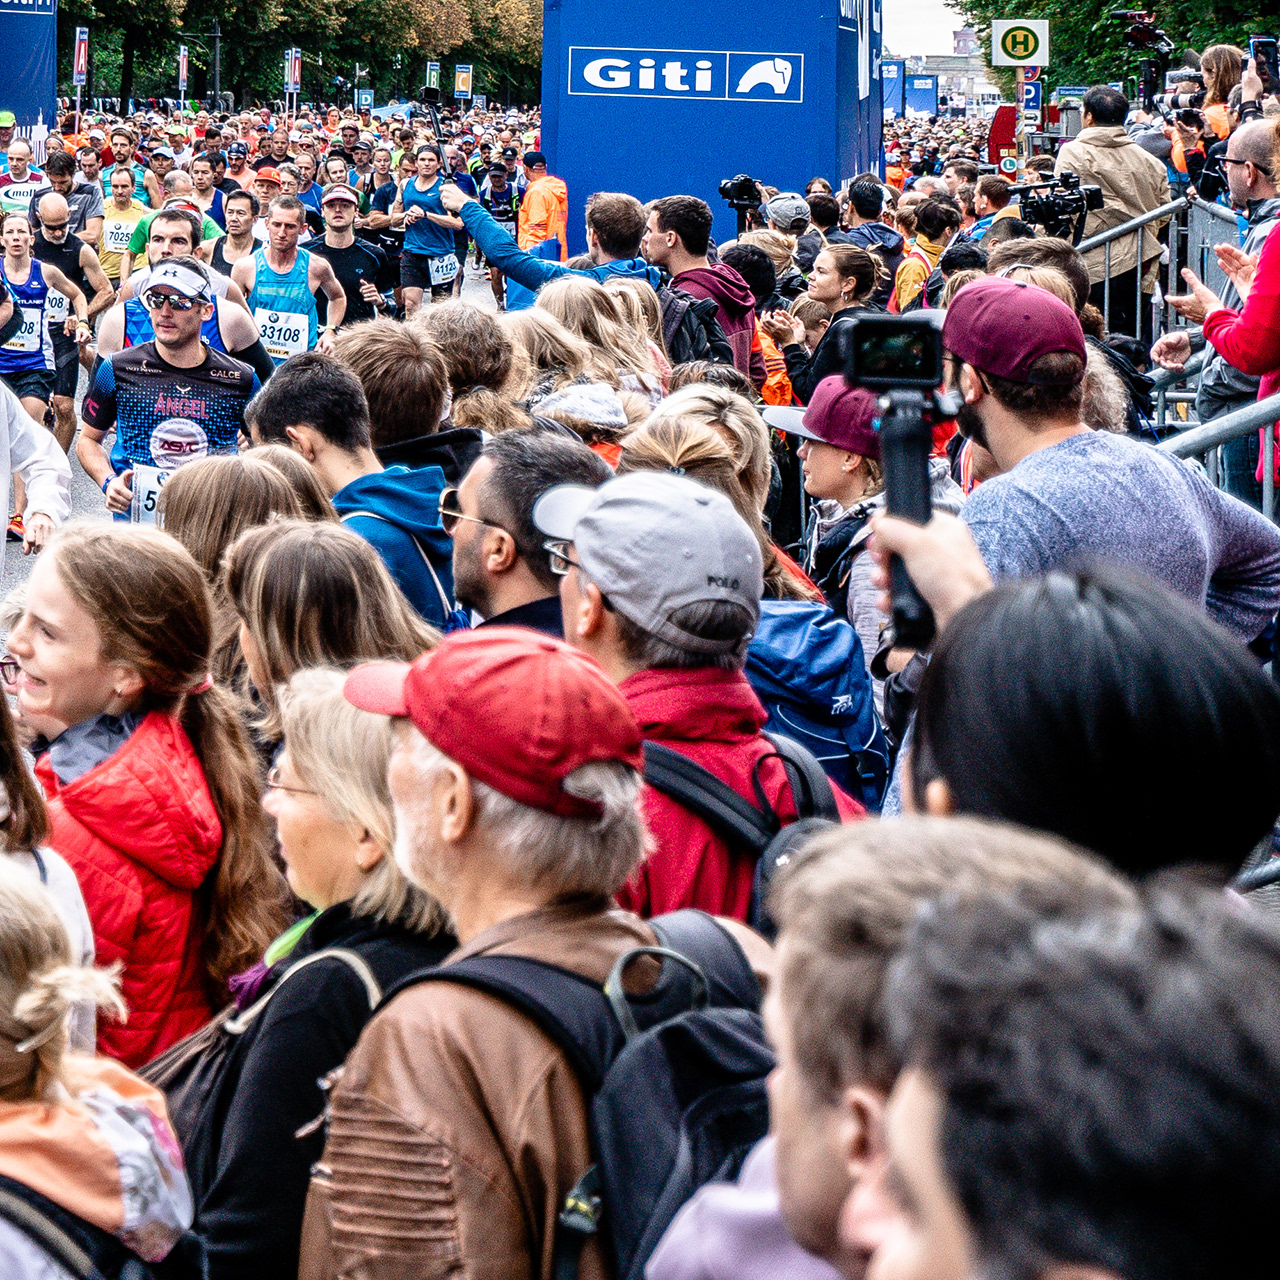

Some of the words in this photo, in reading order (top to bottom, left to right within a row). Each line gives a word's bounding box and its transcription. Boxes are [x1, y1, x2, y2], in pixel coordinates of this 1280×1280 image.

[1011, 34, 1029, 52] H
[77, 45, 86, 72] A
[459, 72, 468, 91] C
[583, 58, 713, 92] Giti
[259, 323, 301, 342] 33108
[154, 392, 210, 420] ÁNGEL
[706, 575, 743, 591] POLO
